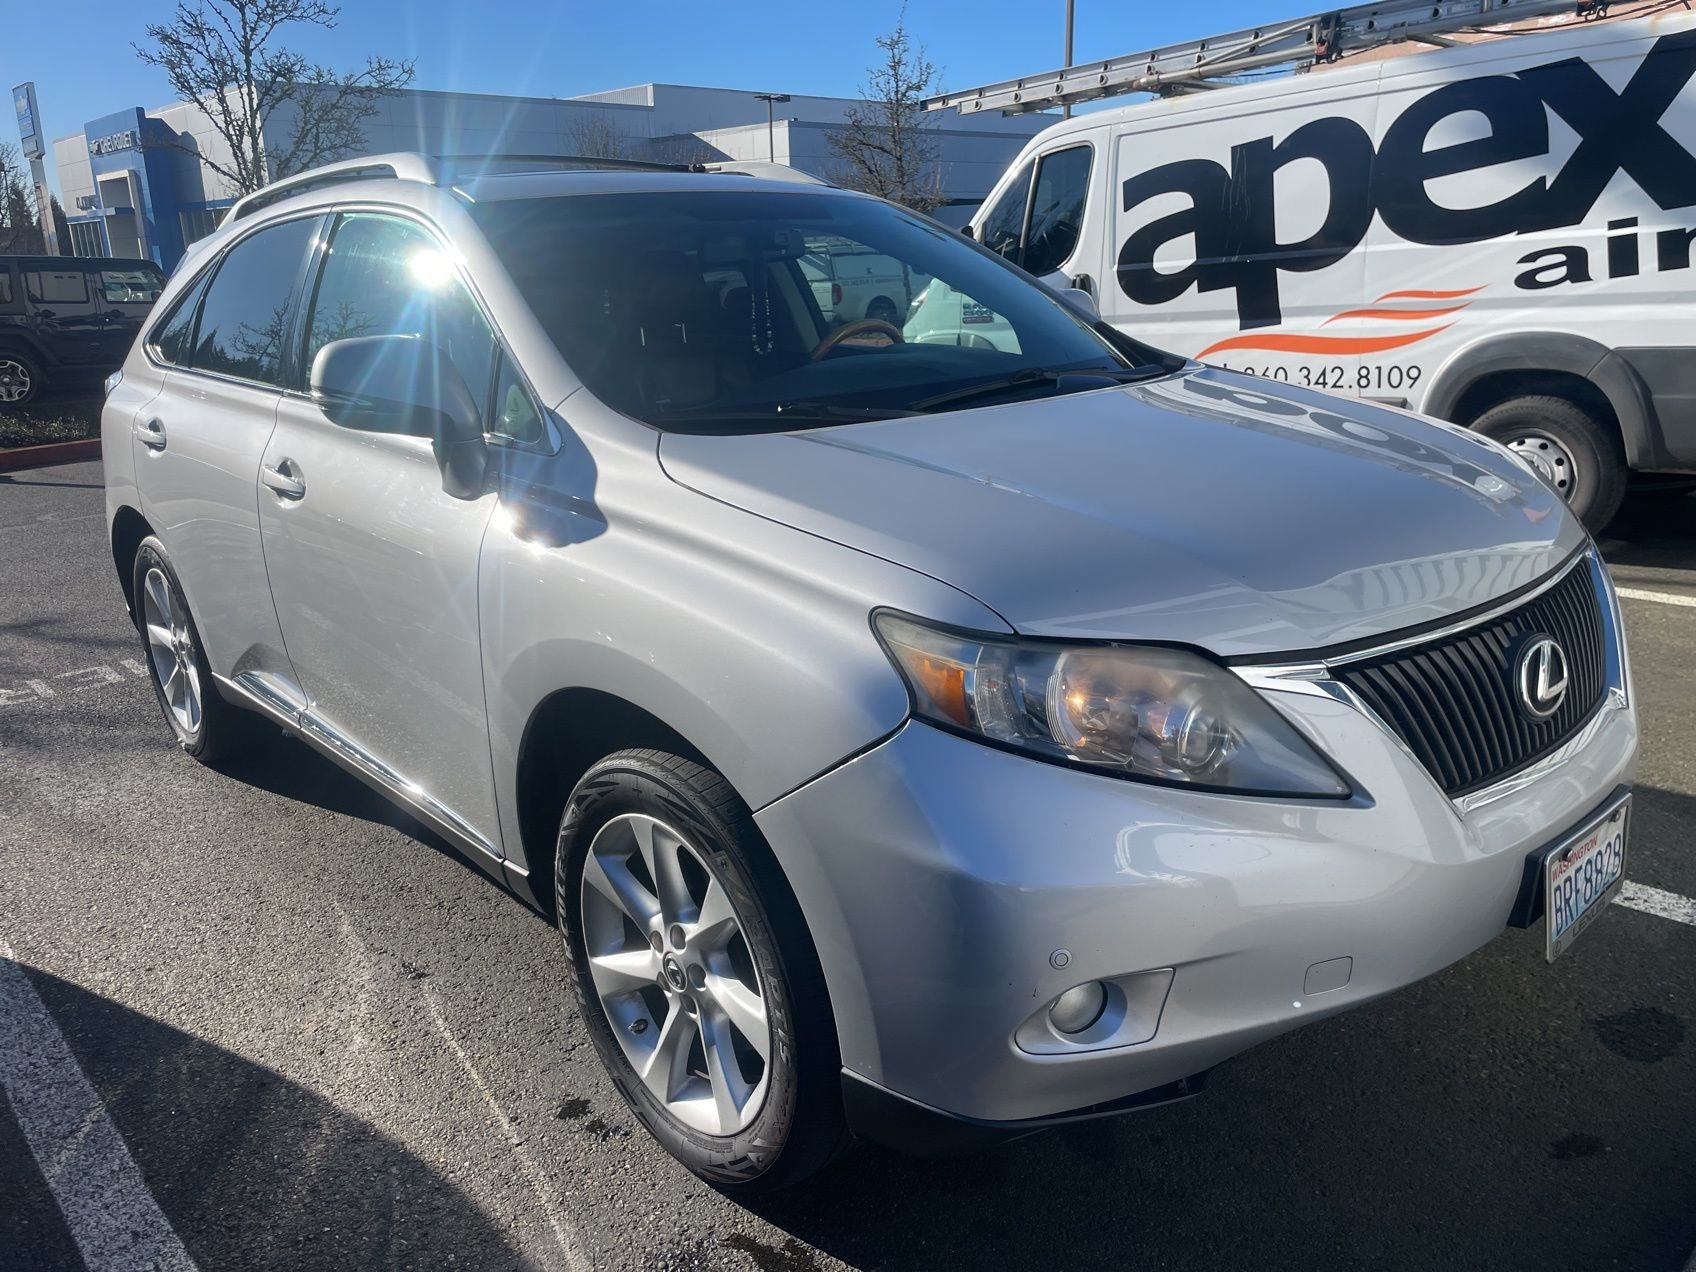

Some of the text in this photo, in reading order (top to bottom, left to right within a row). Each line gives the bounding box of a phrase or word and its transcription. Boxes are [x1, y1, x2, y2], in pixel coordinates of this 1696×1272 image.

[1117, 28, 1696, 331] apex
[1514, 216, 1696, 290] air
[1243, 365, 1422, 389] 0342.8109
